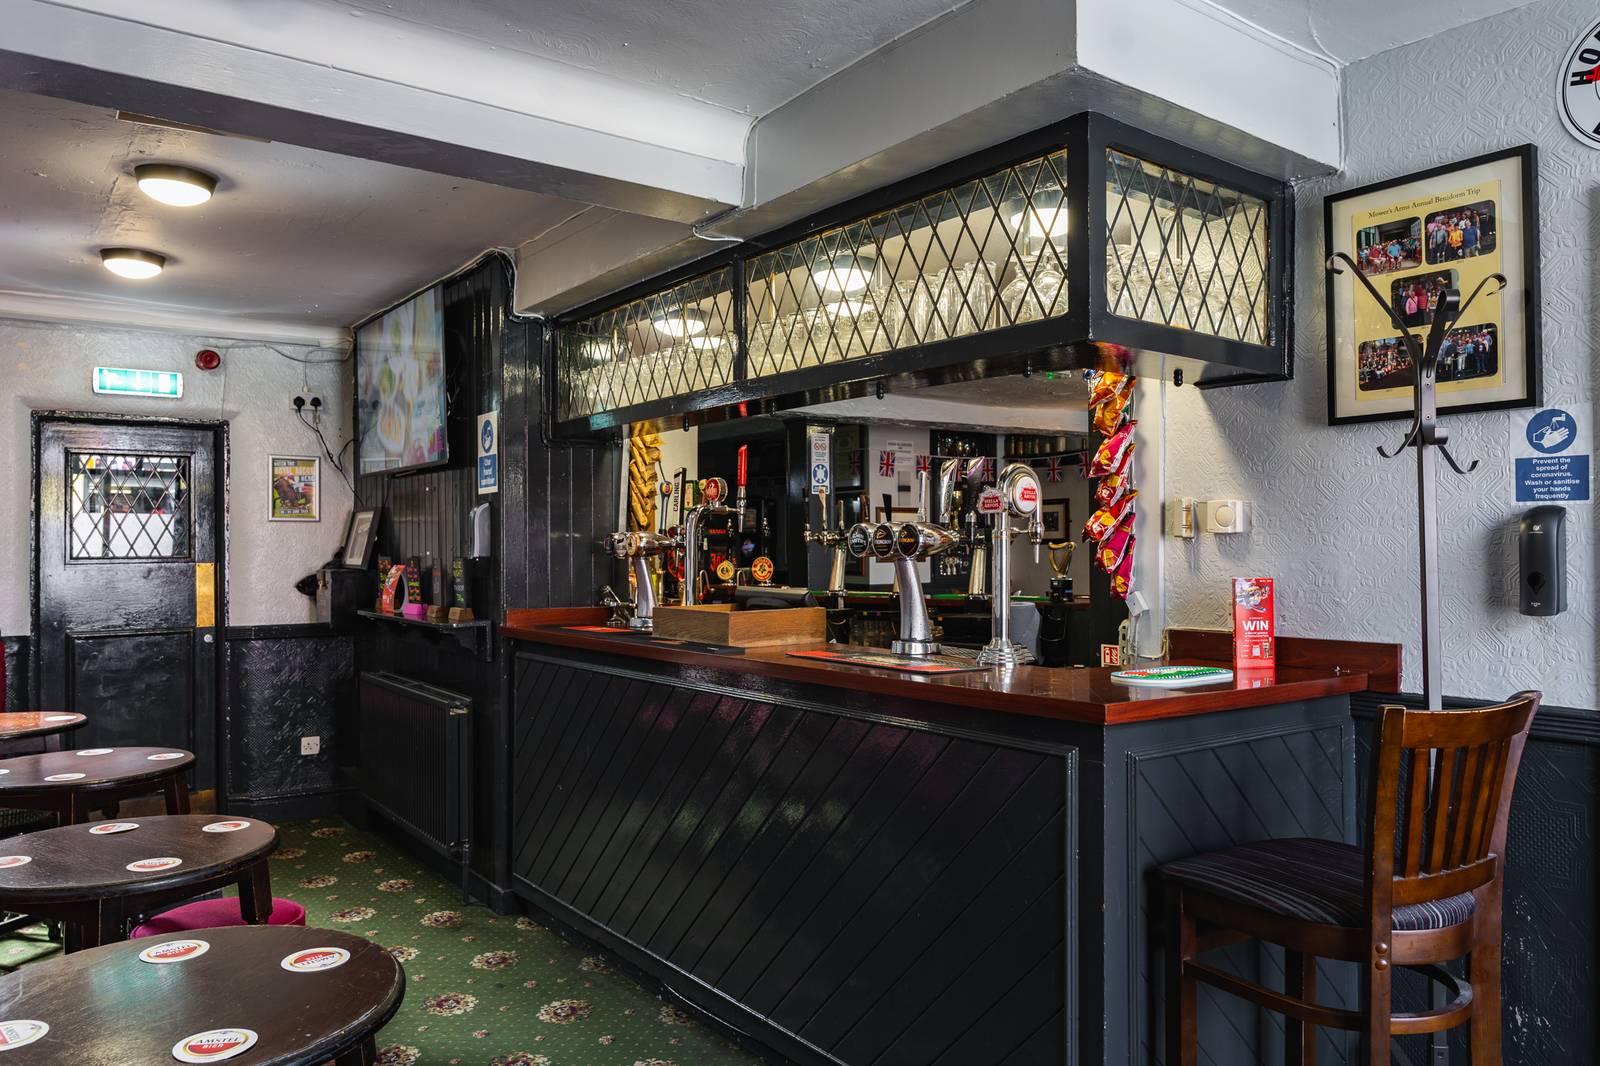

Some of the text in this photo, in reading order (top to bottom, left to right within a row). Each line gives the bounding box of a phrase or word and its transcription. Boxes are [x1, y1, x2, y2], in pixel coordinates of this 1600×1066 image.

[1368, 188, 1481, 218] Mower's Arms Annual Benidorm Trip
[1242, 620, 1269, 631] WIN
[154, 944, 193, 955] AMSTEL
[301, 954, 335, 966] AMSTEL
[196, 1036, 240, 1044] AMSTEL
